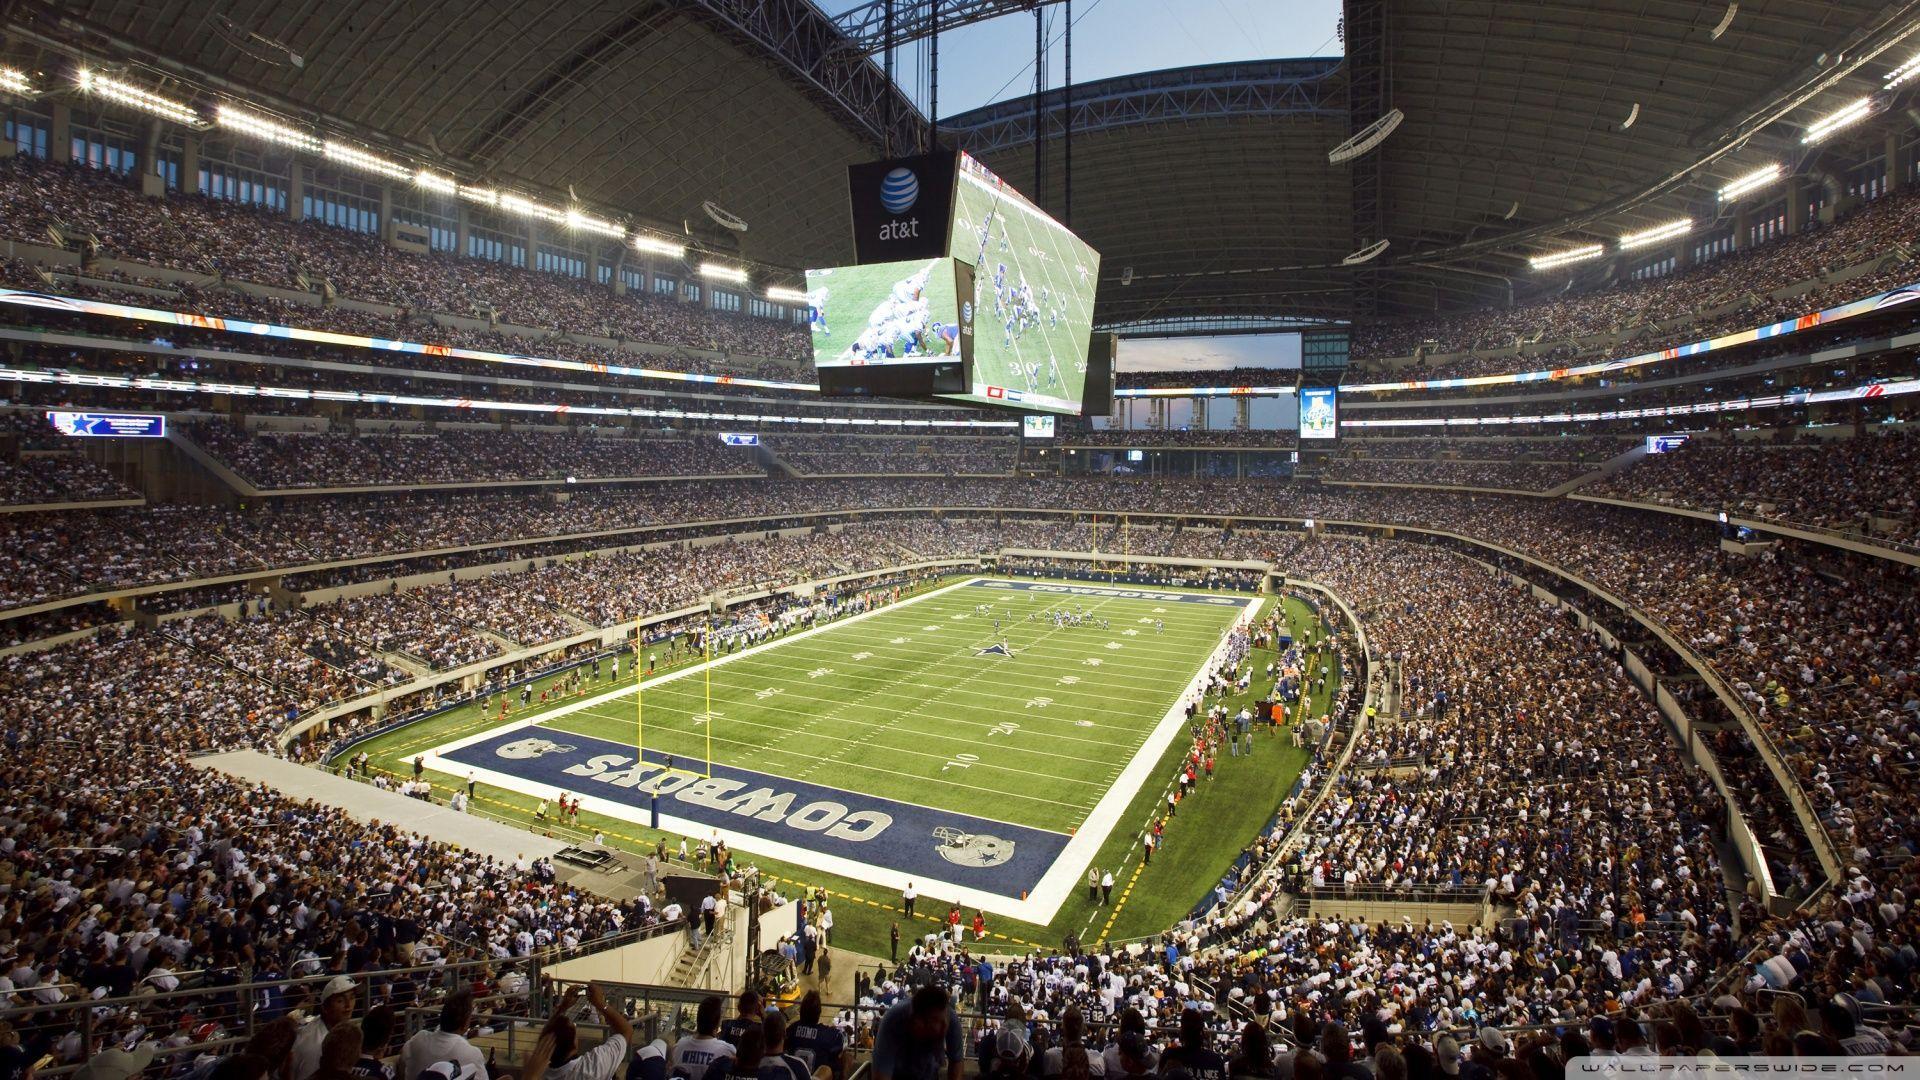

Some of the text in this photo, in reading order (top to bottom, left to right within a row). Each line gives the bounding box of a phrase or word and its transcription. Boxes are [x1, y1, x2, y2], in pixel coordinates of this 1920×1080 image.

[879, 217, 919, 241] at&t
[562, 753, 894, 842] COWBOYS
[729, 1026, 747, 1038] ROM
[795, 1025, 818, 1040] ROMO
[682, 1050, 715, 1065] WHITE
